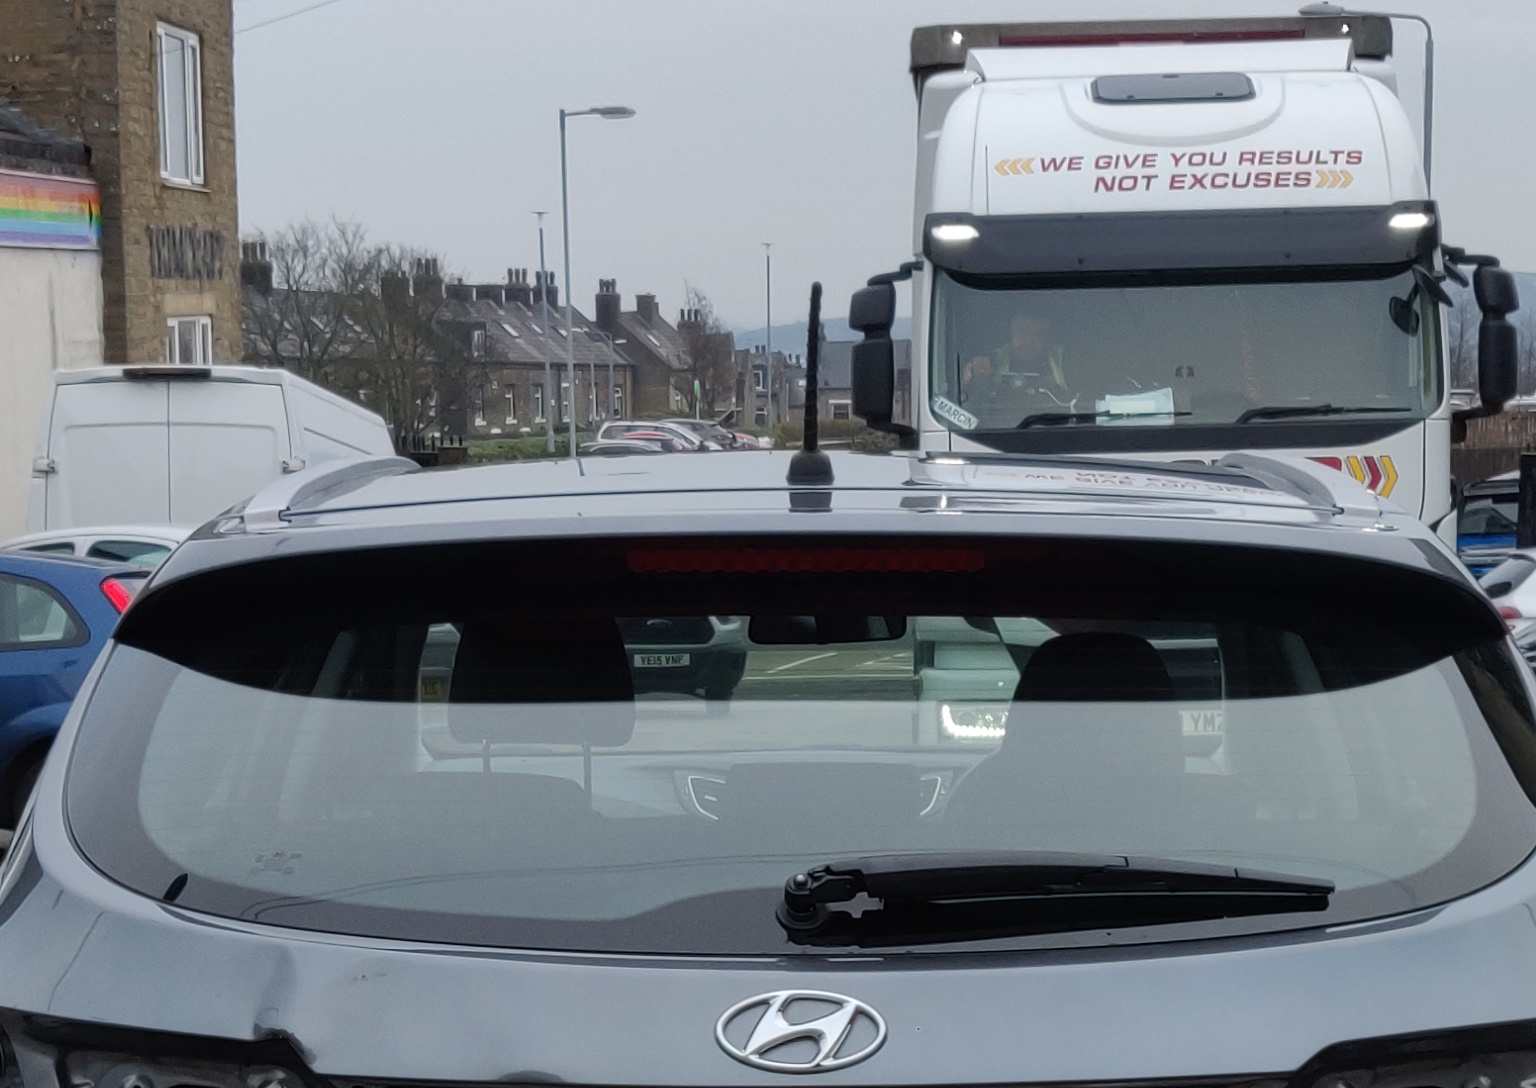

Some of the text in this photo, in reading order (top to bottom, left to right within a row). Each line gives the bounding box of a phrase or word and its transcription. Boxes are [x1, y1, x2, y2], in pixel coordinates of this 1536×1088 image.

[1039, 150, 1363, 172] WE GIVE YOU RESULTS
[1094, 171, 1313, 193] NOT EXCUSES
